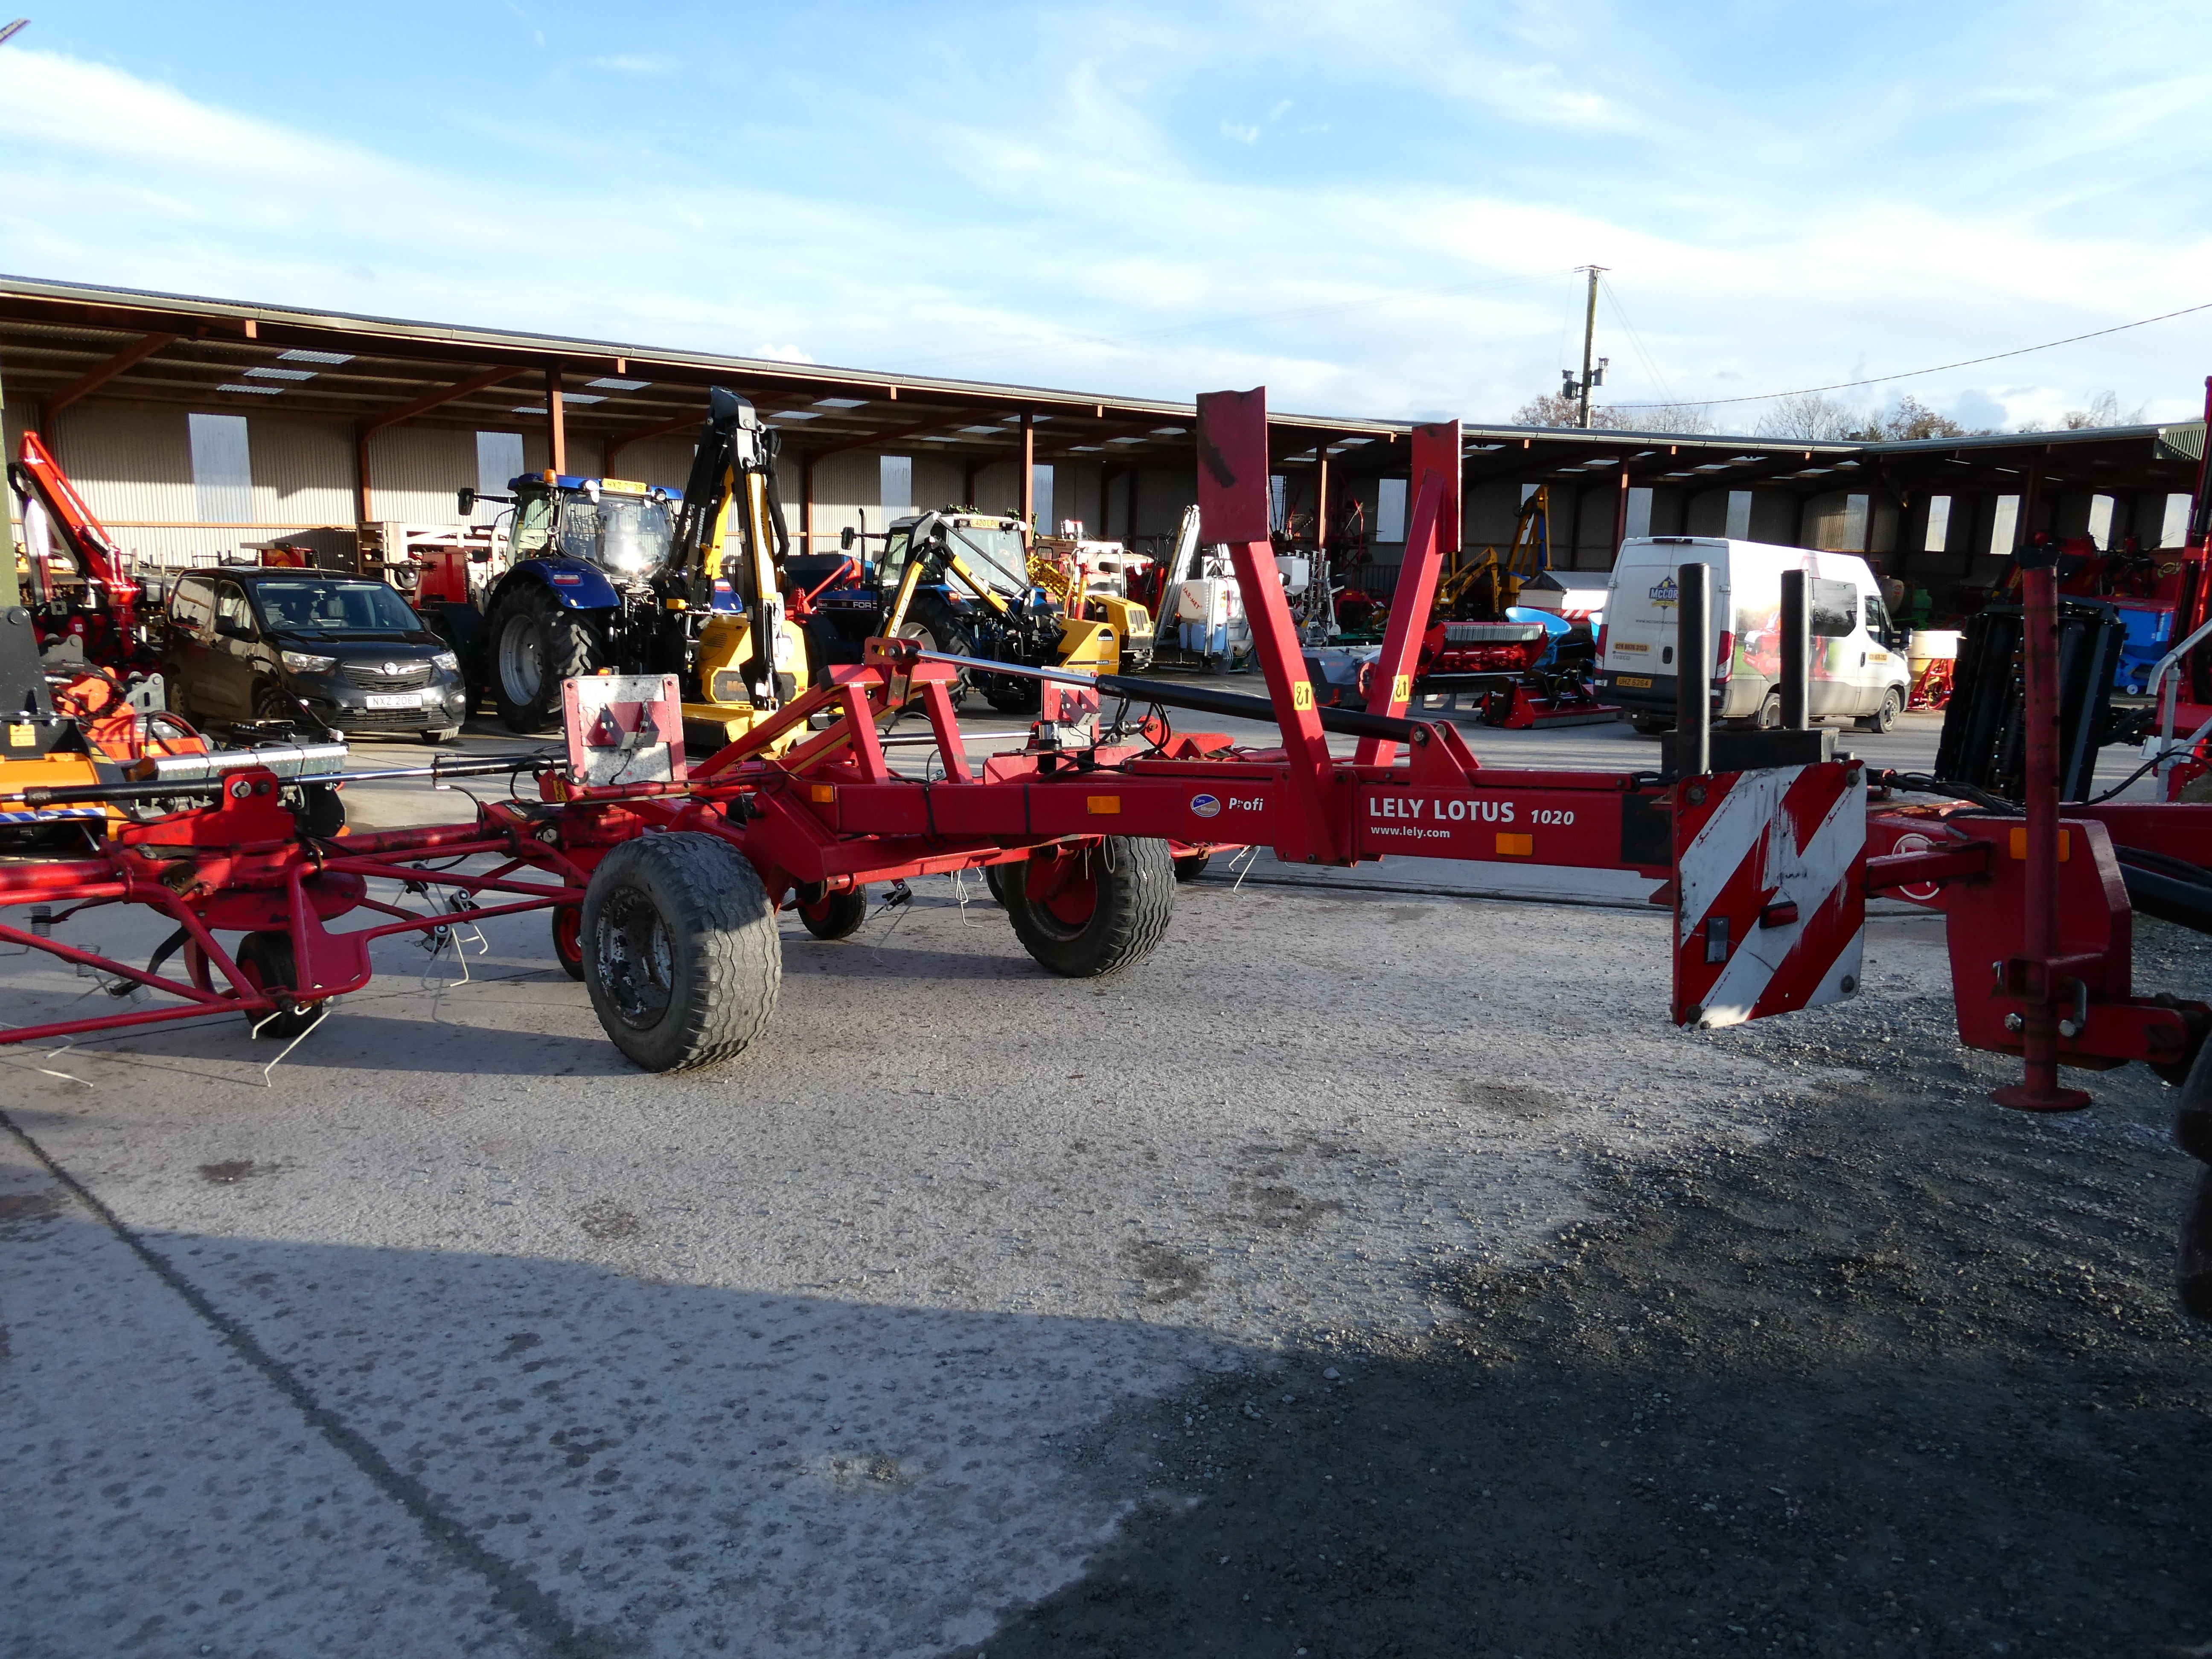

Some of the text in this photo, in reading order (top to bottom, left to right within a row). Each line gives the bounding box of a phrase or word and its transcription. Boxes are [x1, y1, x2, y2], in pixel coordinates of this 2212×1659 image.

[607, 481, 621, 489] HXZ
[373, 696, 416, 705] NXZ 2061
[1370, 797, 1575, 825] LELY LOTUS 1020
[1371, 826, 1450, 838] www.lely.com
